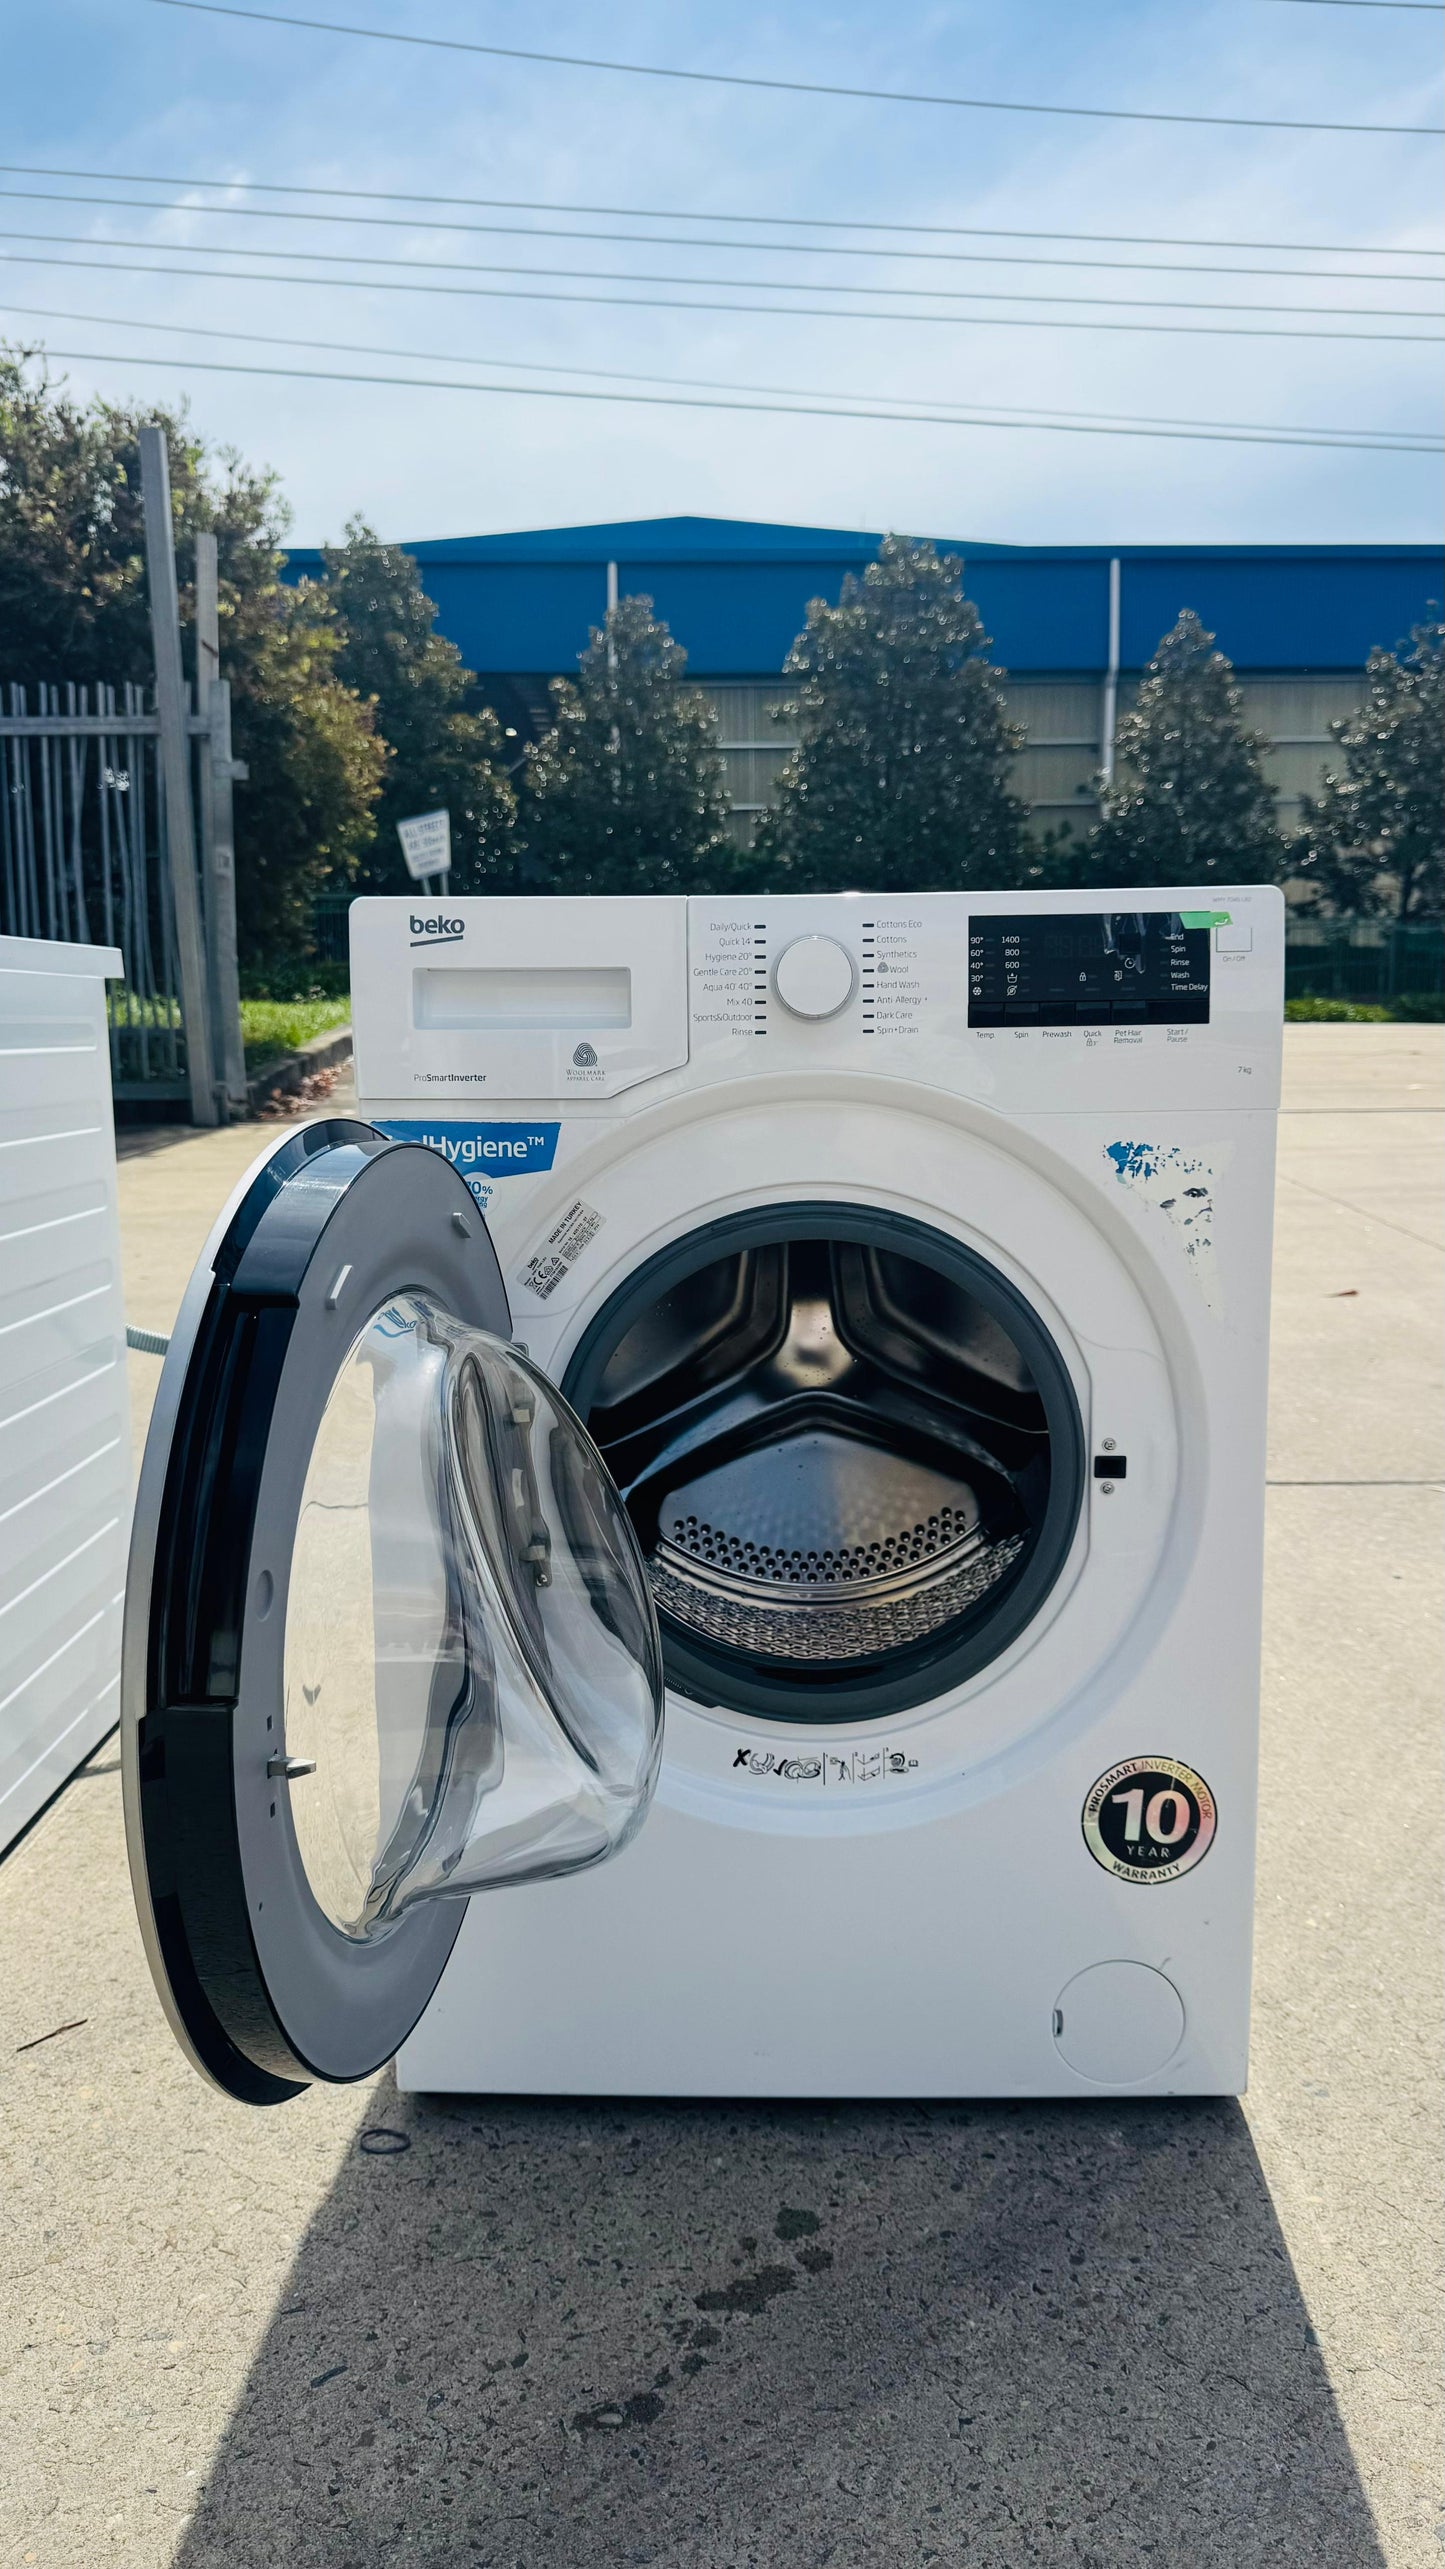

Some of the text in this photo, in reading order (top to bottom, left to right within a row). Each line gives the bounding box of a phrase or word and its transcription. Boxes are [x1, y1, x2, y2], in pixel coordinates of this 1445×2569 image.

[409, 914, 465, 934] beko
[710, 923, 752, 932] Daily/Quick
[876, 920, 922, 928] Cottons Eco
[719, 937, 740, 947] Quick
[876, 936, 907, 944] Cottons
[970, 936, 984, 944] 90°
[1001, 936, 1020, 944] 1400
[970, 949, 984, 957] 60°
[1170, 945, 1186, 953] Spin
[705, 953, 737, 962] Hygiene
[876, 950, 917, 960] Synthetics
[889, 965, 909, 973] Wool
[1004, 961, 1020, 969] 600
[693, 968, 718, 976] Gentle
[720, 968, 737, 976] Care
[1170, 971, 1190, 979] Wash
[703, 983, 723, 992] Aqua
[876, 981, 920, 989] Hand Wash
[1171, 983, 1208, 992] Time Delay
[726, 998, 753, 1006] Mix 40
[693, 1013, 752, 1022] Sports&Outdoor
[876, 1011, 913, 1019] Dark Care
[731, 1028, 753, 1036] Rinse
[1014, 1031, 1029, 1039] Spin
[1042, 1030, 1072, 1038] Prewash
[1083, 1030, 1102, 1038] Quick
[1113, 1036, 1143, 1044] Removal
[414, 1073, 487, 1082] ProSmartInverter
[548, 1228, 562, 1244] MADE
[560, 1222, 567, 1230] IN
[564, 1201, 583, 1223] TURKEY
[1087, 1760, 1213, 1820] PROSMART INVERTER MOTOR
[1112, 1788, 1191, 1845] 10
[1127, 1845, 1171, 1858] YEAR
[1112, 1861, 1181, 1880] WARRANTY
